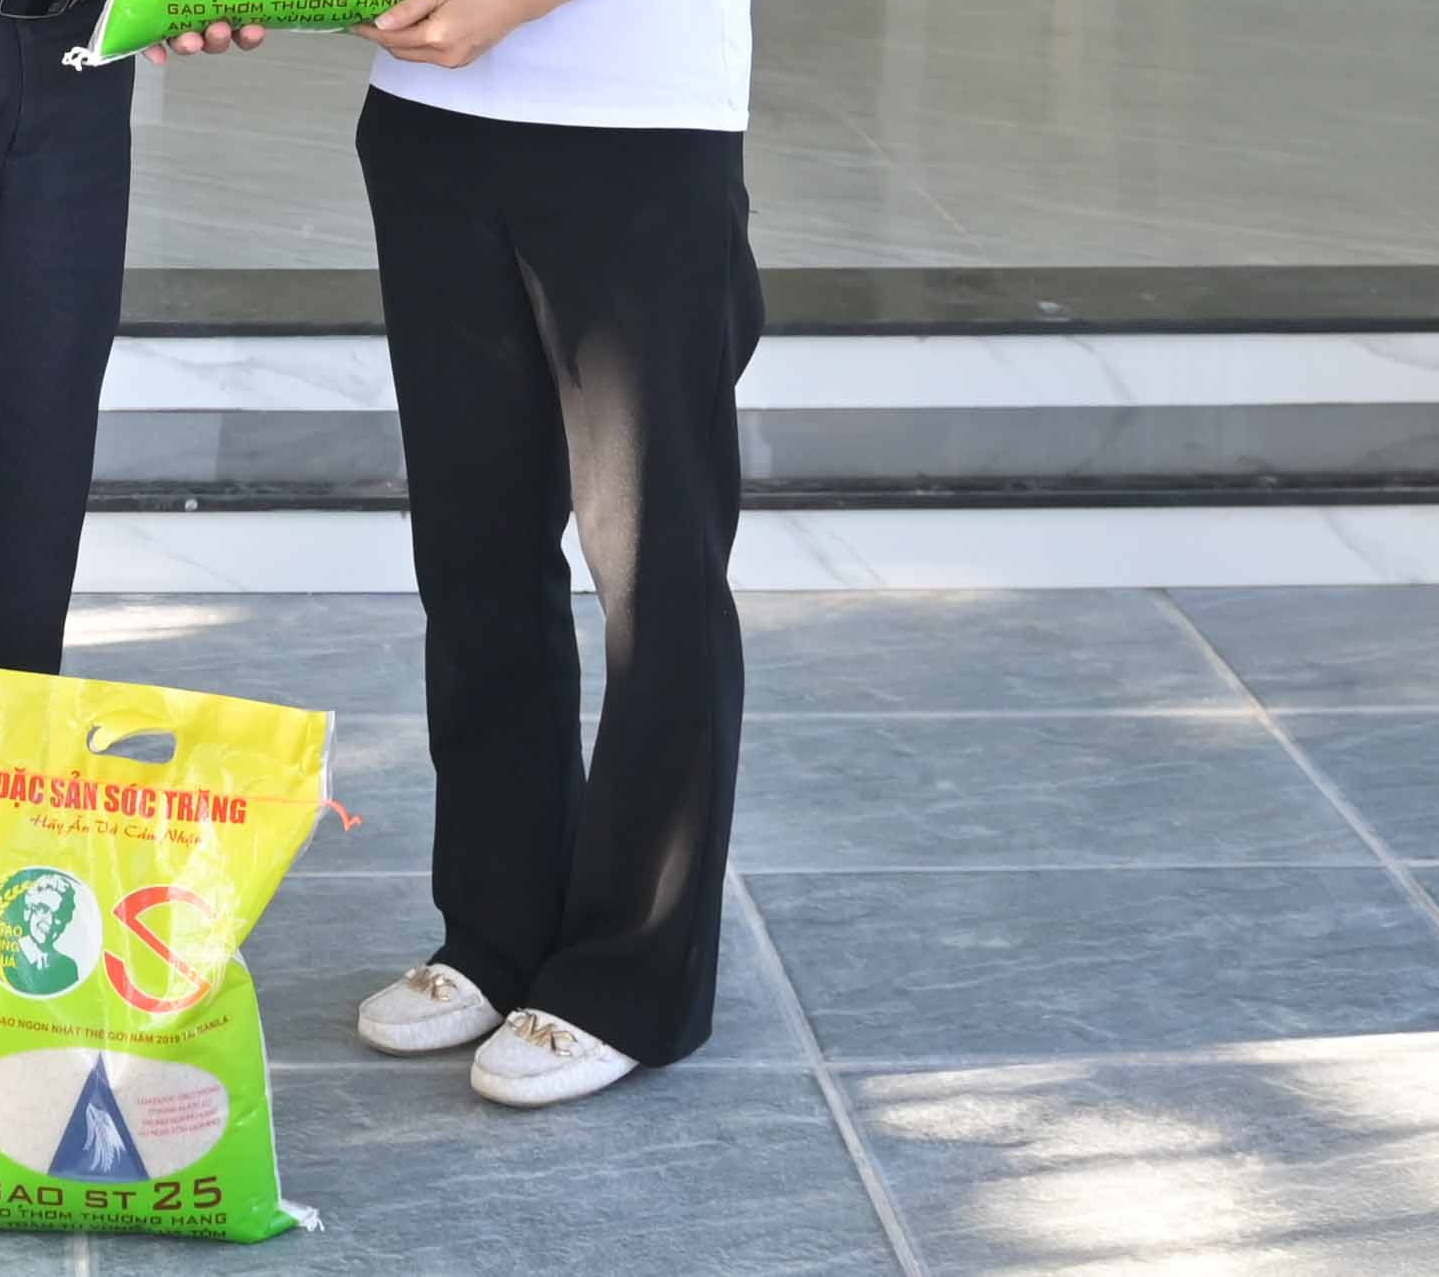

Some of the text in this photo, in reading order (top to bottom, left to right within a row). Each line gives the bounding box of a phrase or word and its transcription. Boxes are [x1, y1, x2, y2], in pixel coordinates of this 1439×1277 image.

[213, 0, 264, 15] THƠM
[50, 770, 98, 810] SẢN
[104, 783, 155, 819] SÓC
[164, 789, 247, 824] TRĂNG
[85, 1190, 136, 1209] ST
[153, 1176, 222, 1211] 25
